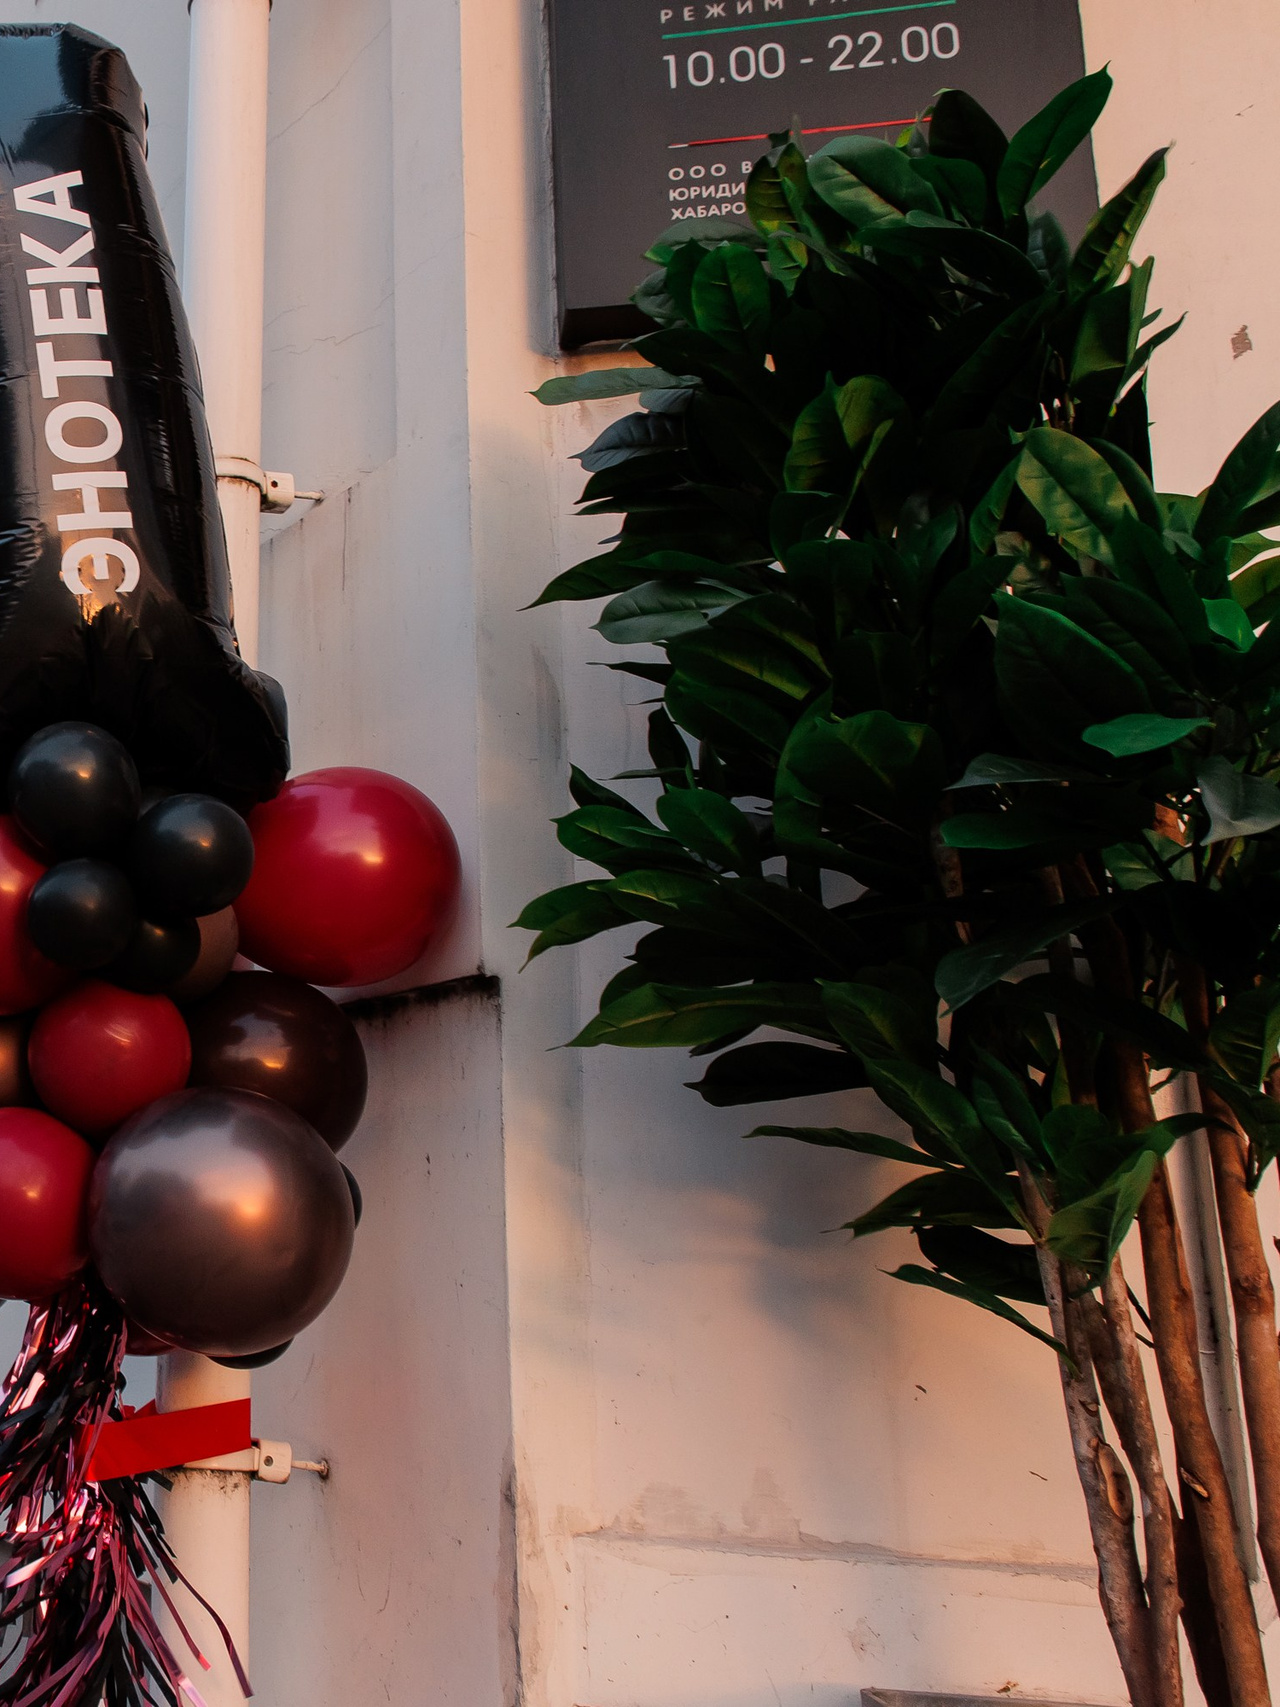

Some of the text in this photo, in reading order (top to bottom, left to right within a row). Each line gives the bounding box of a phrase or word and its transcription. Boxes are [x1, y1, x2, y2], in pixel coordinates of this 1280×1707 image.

[660, 0, 784, 24] РЕЖИМ
[662, 42, 786, 89] 10.00
[827, 22, 960, 72] 22.00
[668, 163, 727, 181] ООО
[669, 181, 746, 201] ЮРИДИ
[670, 201, 747, 220] ХАБАРО
[13, 170, 141, 595] ЭНОТЕКА
